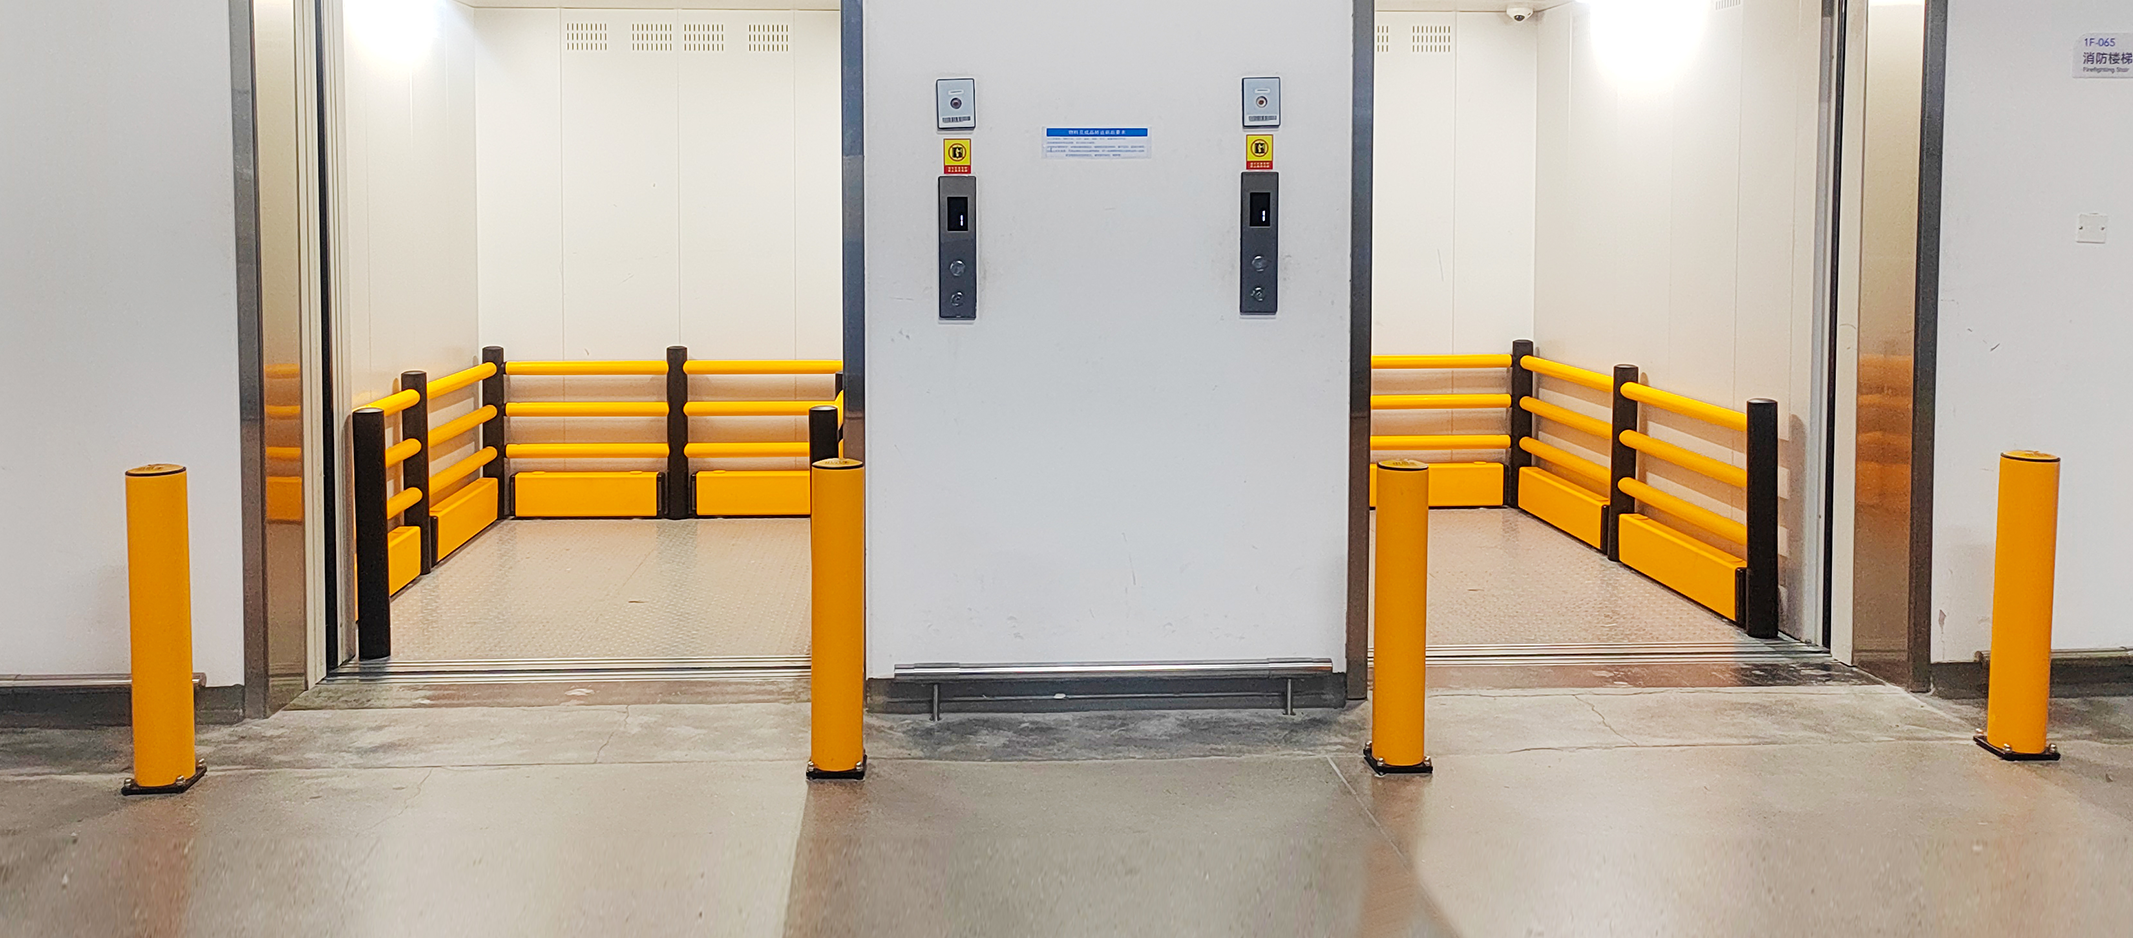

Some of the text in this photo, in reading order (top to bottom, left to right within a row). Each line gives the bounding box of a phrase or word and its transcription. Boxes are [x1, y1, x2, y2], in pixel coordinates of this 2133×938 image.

[2084, 37, 2116, 47] 1F-065
[2082, 51, 2133, 65] 消防楼梯
